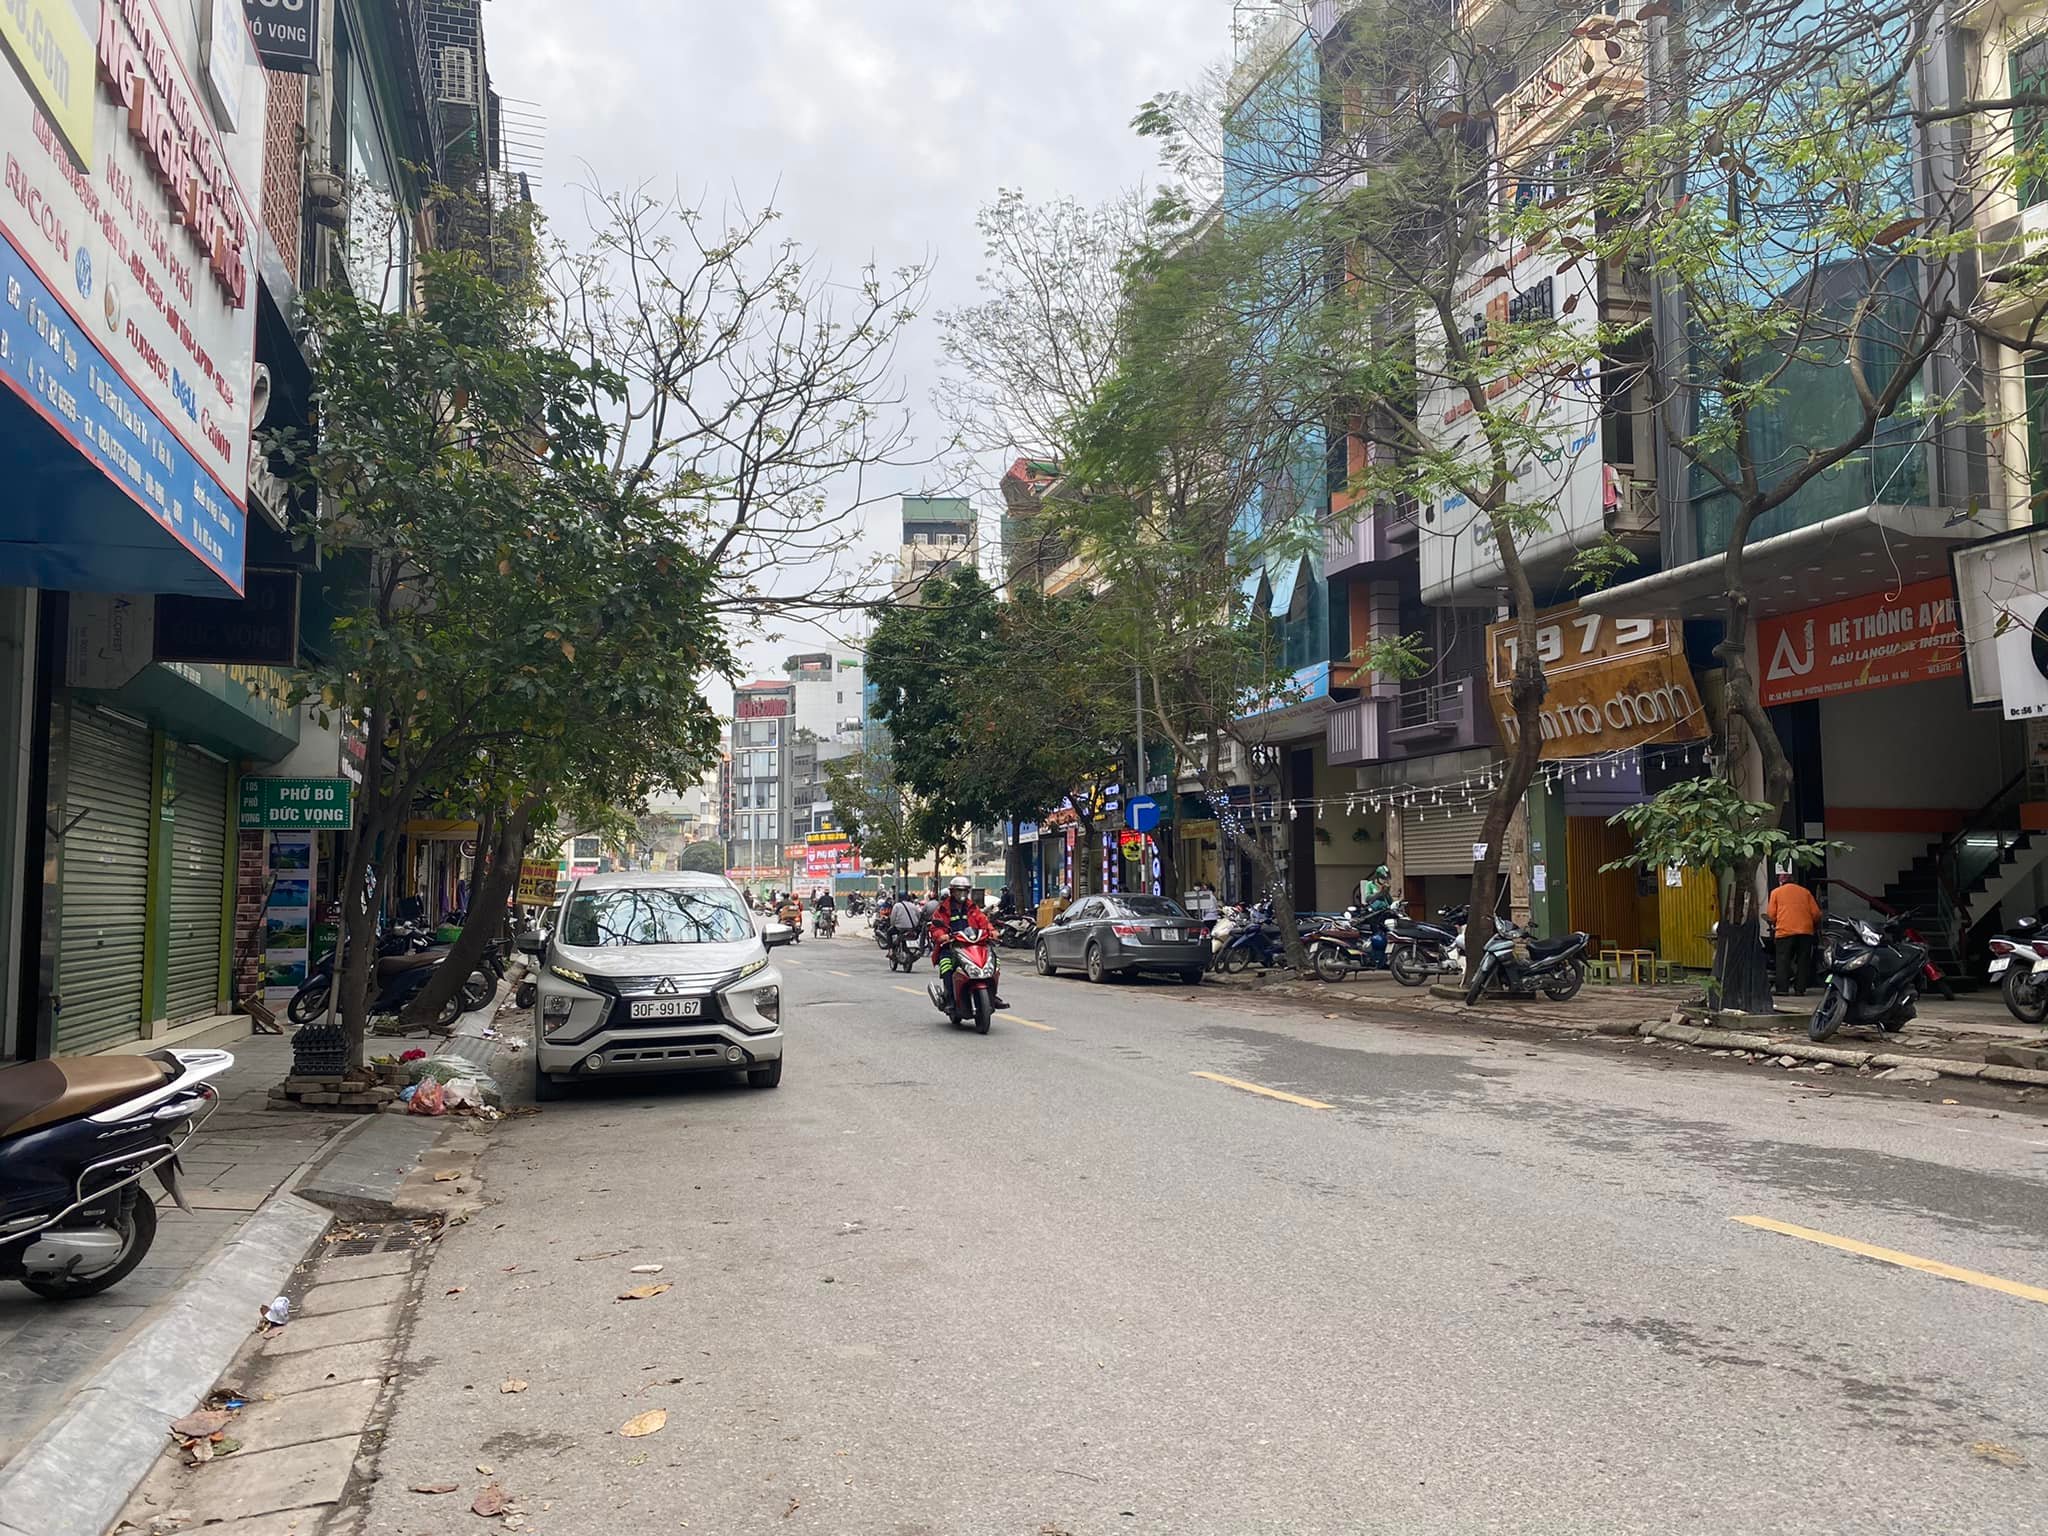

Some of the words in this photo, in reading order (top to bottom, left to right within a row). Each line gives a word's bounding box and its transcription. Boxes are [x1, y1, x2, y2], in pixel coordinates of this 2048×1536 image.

[268, 23, 306, 42] VỌNG
[106, 153, 134, 221] NHÀ
[136, 199, 168, 270] PHÂN
[169, 252, 193, 309] PHỐI
[5, 152, 70, 263] RICOH
[200, 407, 231, 464] Canon
[1829, 617, 1851, 647] HỆ
[1853, 606, 1914, 642] THỐNG
[1556, 696, 1602, 738] trà
[1604, 682, 1695, 730] chanh
[280, 784, 312, 801] PHỞ
[314, 786, 335, 801] BÒ
[269, 805, 300, 821] ĐỨC
[304, 809, 345, 825] VỌNG
